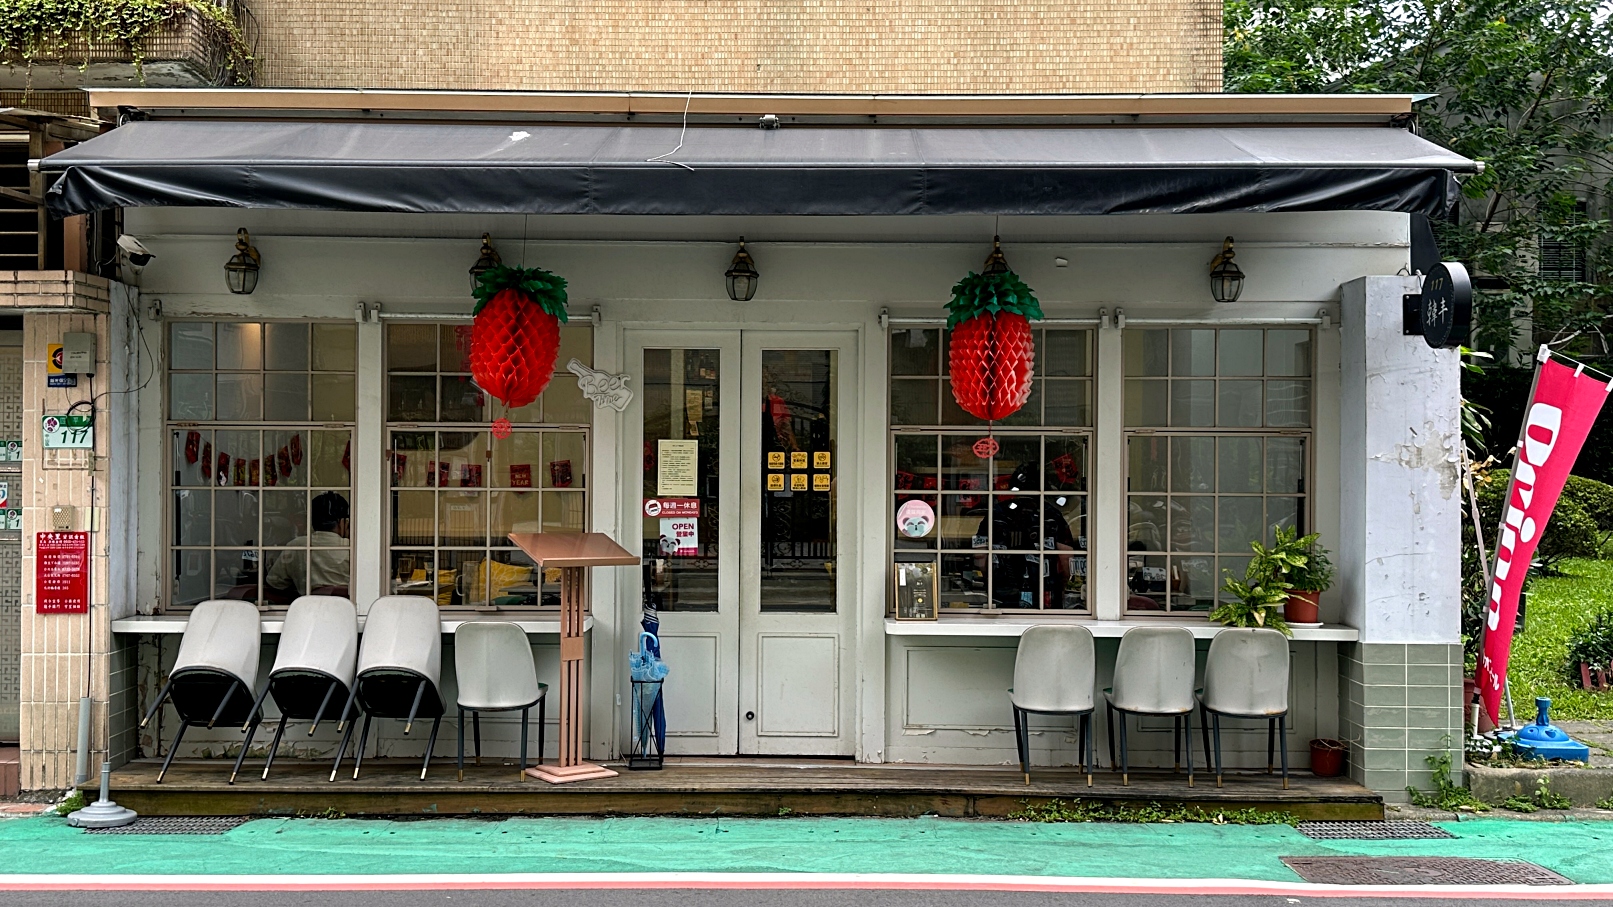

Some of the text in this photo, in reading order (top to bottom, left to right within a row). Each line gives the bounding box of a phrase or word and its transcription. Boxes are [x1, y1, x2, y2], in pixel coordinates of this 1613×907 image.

[1430, 277, 1444, 292] 117
[579, 374, 631, 396] Beer
[61, 430, 88, 444] 117
